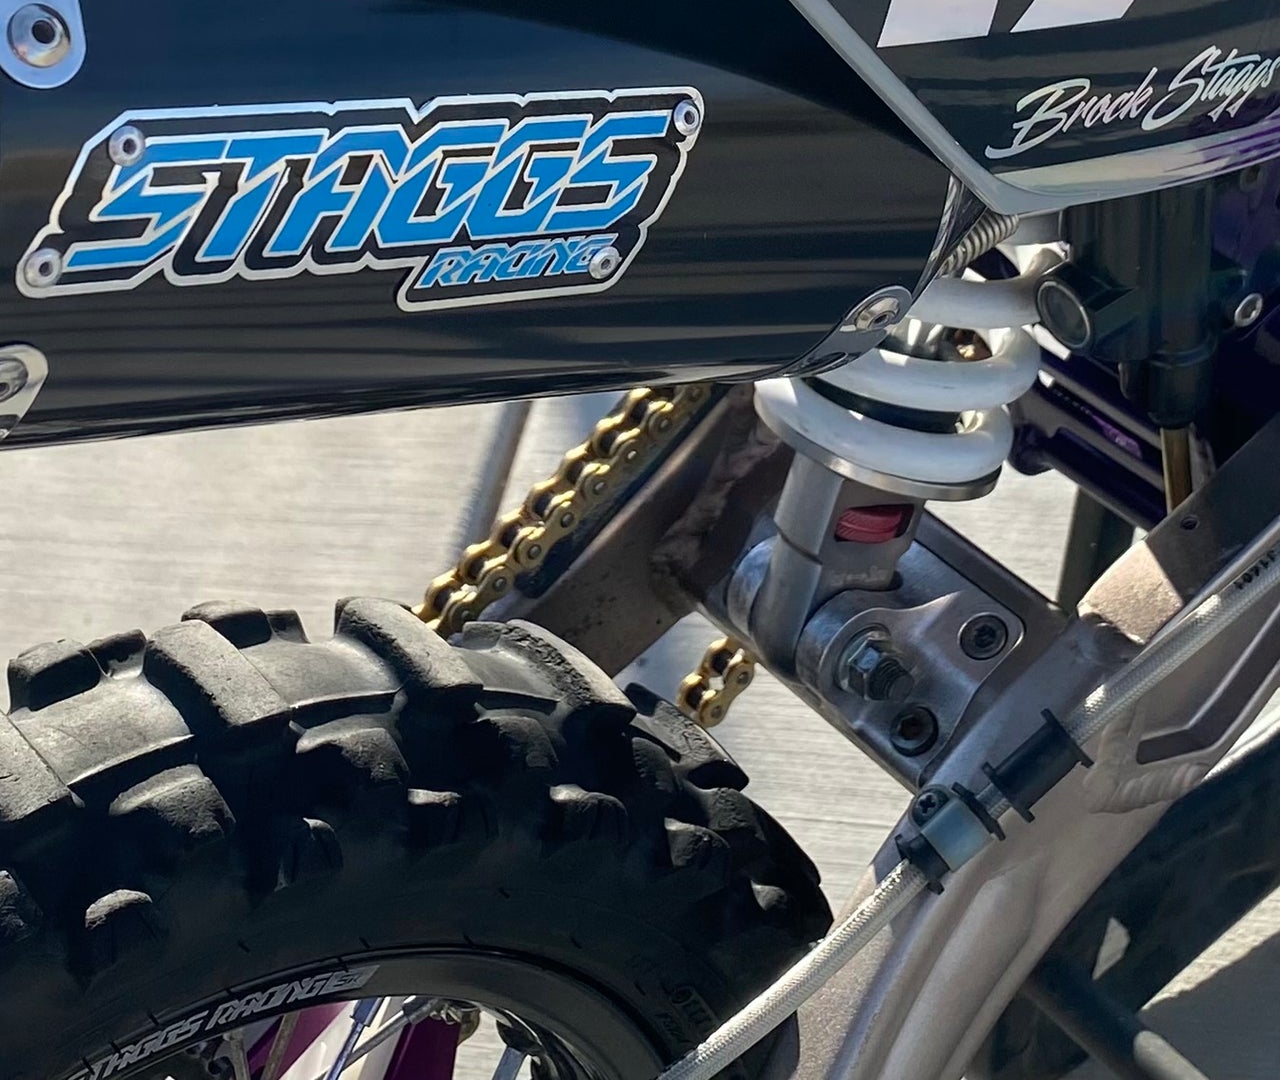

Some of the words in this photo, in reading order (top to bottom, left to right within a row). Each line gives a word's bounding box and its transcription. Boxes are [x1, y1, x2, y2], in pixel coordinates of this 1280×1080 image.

[984, 67, 1158, 159] Brock
[65, 110, 677, 269] STAGGS
[414, 233, 619, 289] RACING
